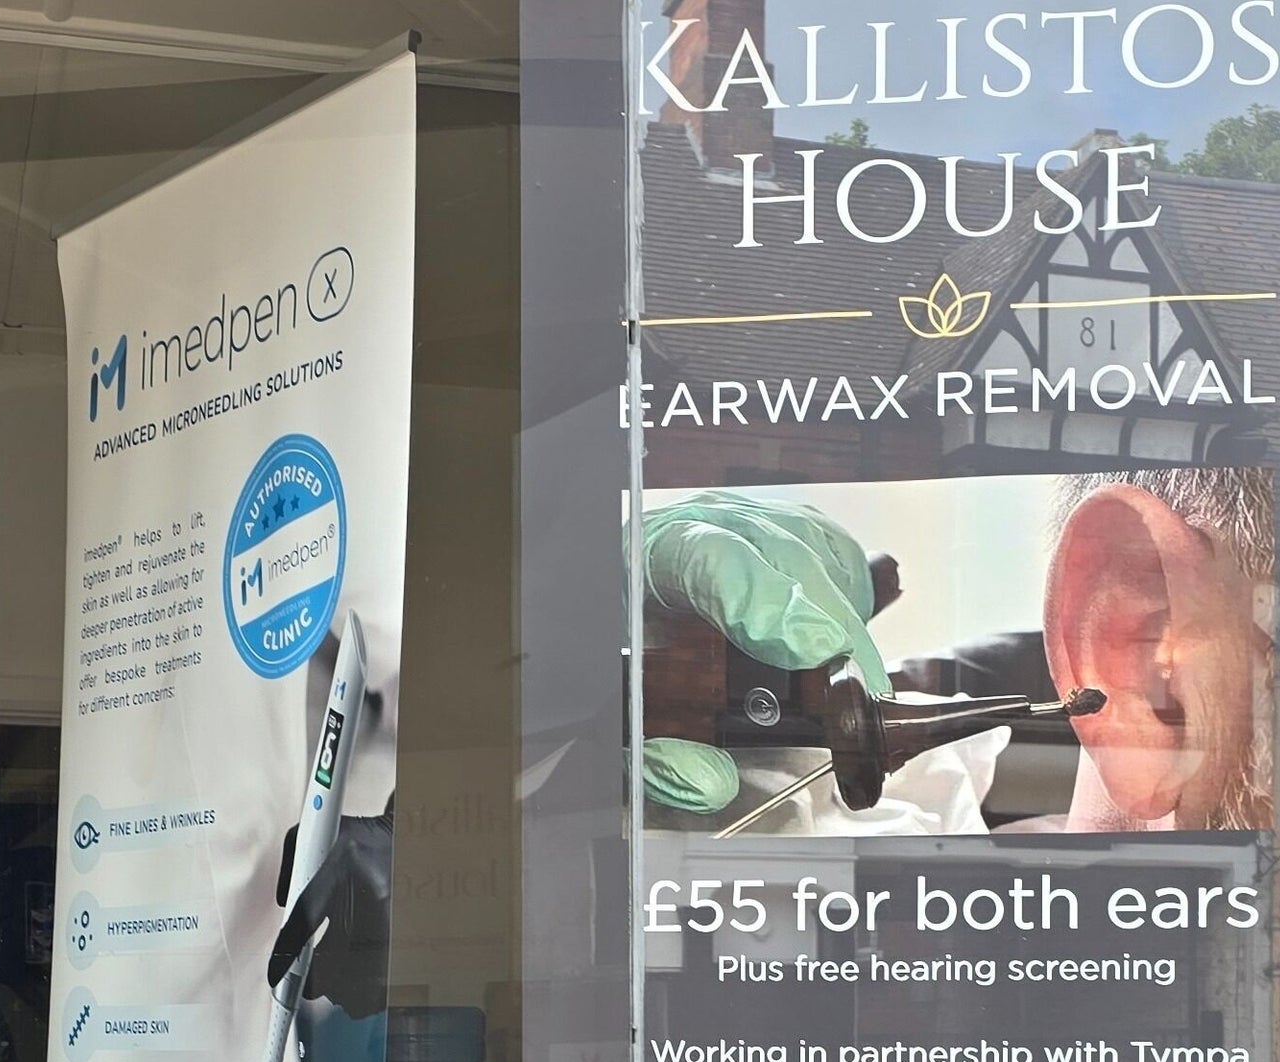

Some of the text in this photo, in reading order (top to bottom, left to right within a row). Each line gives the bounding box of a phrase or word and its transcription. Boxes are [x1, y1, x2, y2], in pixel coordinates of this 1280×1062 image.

[636, 0, 1280, 116] KALLISTOS
[734, 143, 1162, 249] HOUSE
[142, 284, 296, 390] imedpen
[94, 350, 342, 461] ADVANCED MICRONEEDLING SOLUTIONS
[620, 359, 1276, 430] EARWAX REMOVAL
[244, 464, 322, 537] AUTHORISED
[134, 529, 161, 548] helps
[190, 512, 205, 529] lift,
[83, 541, 205, 589] tighten and rejuvenate the
[82, 568, 204, 614] skin well allowing for
[81, 596, 203, 639] deeper penetration active
[132, 627, 189, 652] into the skin
[263, 607, 312, 650] CLINIC
[109, 809, 216, 837] FINE LINES & WRINKLES
[107, 916, 198, 936] HYPERPIGMENTATION
[643, 875, 1258, 932] £55 for both ears
[719, 954, 1175, 985] Plus free hearing screening
[105, 1020, 169, 1034] DAMAGED SKIN
